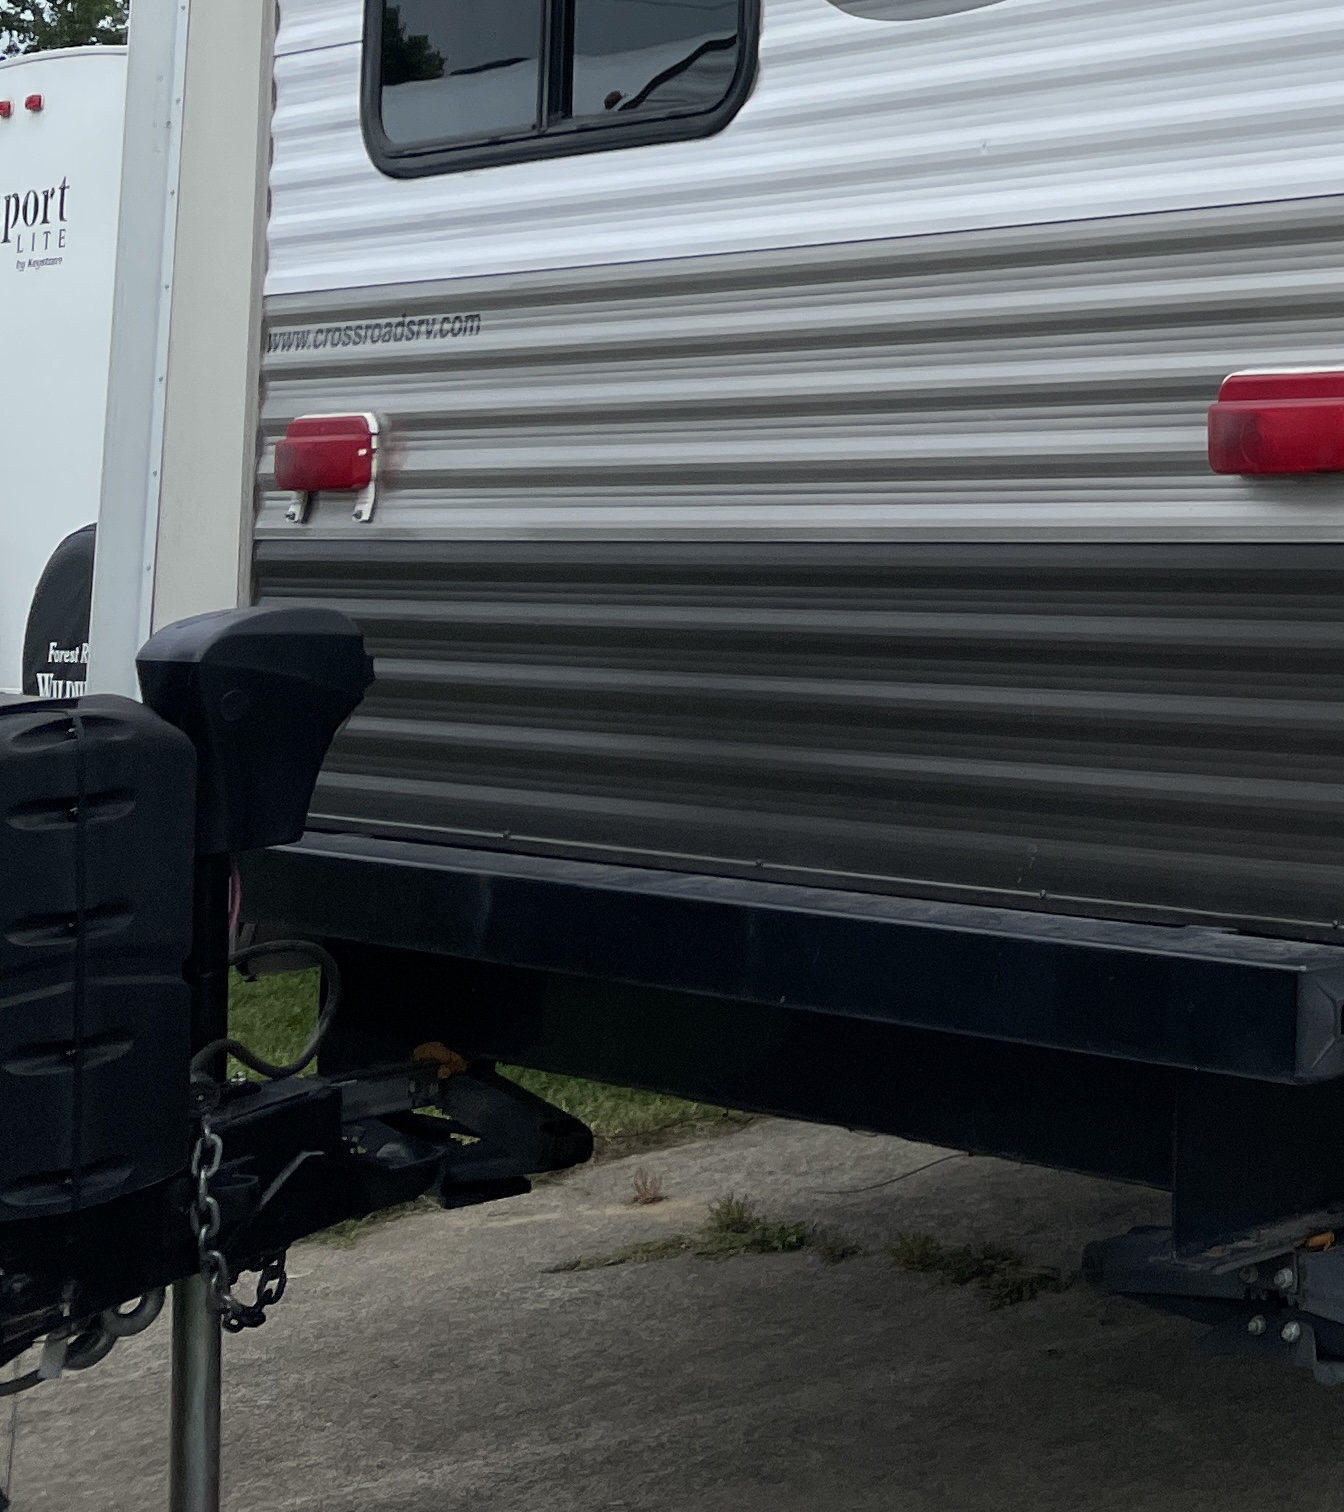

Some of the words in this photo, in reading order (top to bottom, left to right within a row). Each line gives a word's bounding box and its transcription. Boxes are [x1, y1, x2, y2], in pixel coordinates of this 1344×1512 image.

[1, 176, 70, 244] port
[16, 228, 66, 253] LITE
[267, 313, 481, 353] www.crossroadsrv.com
[48, 641, 79, 663] Forest
